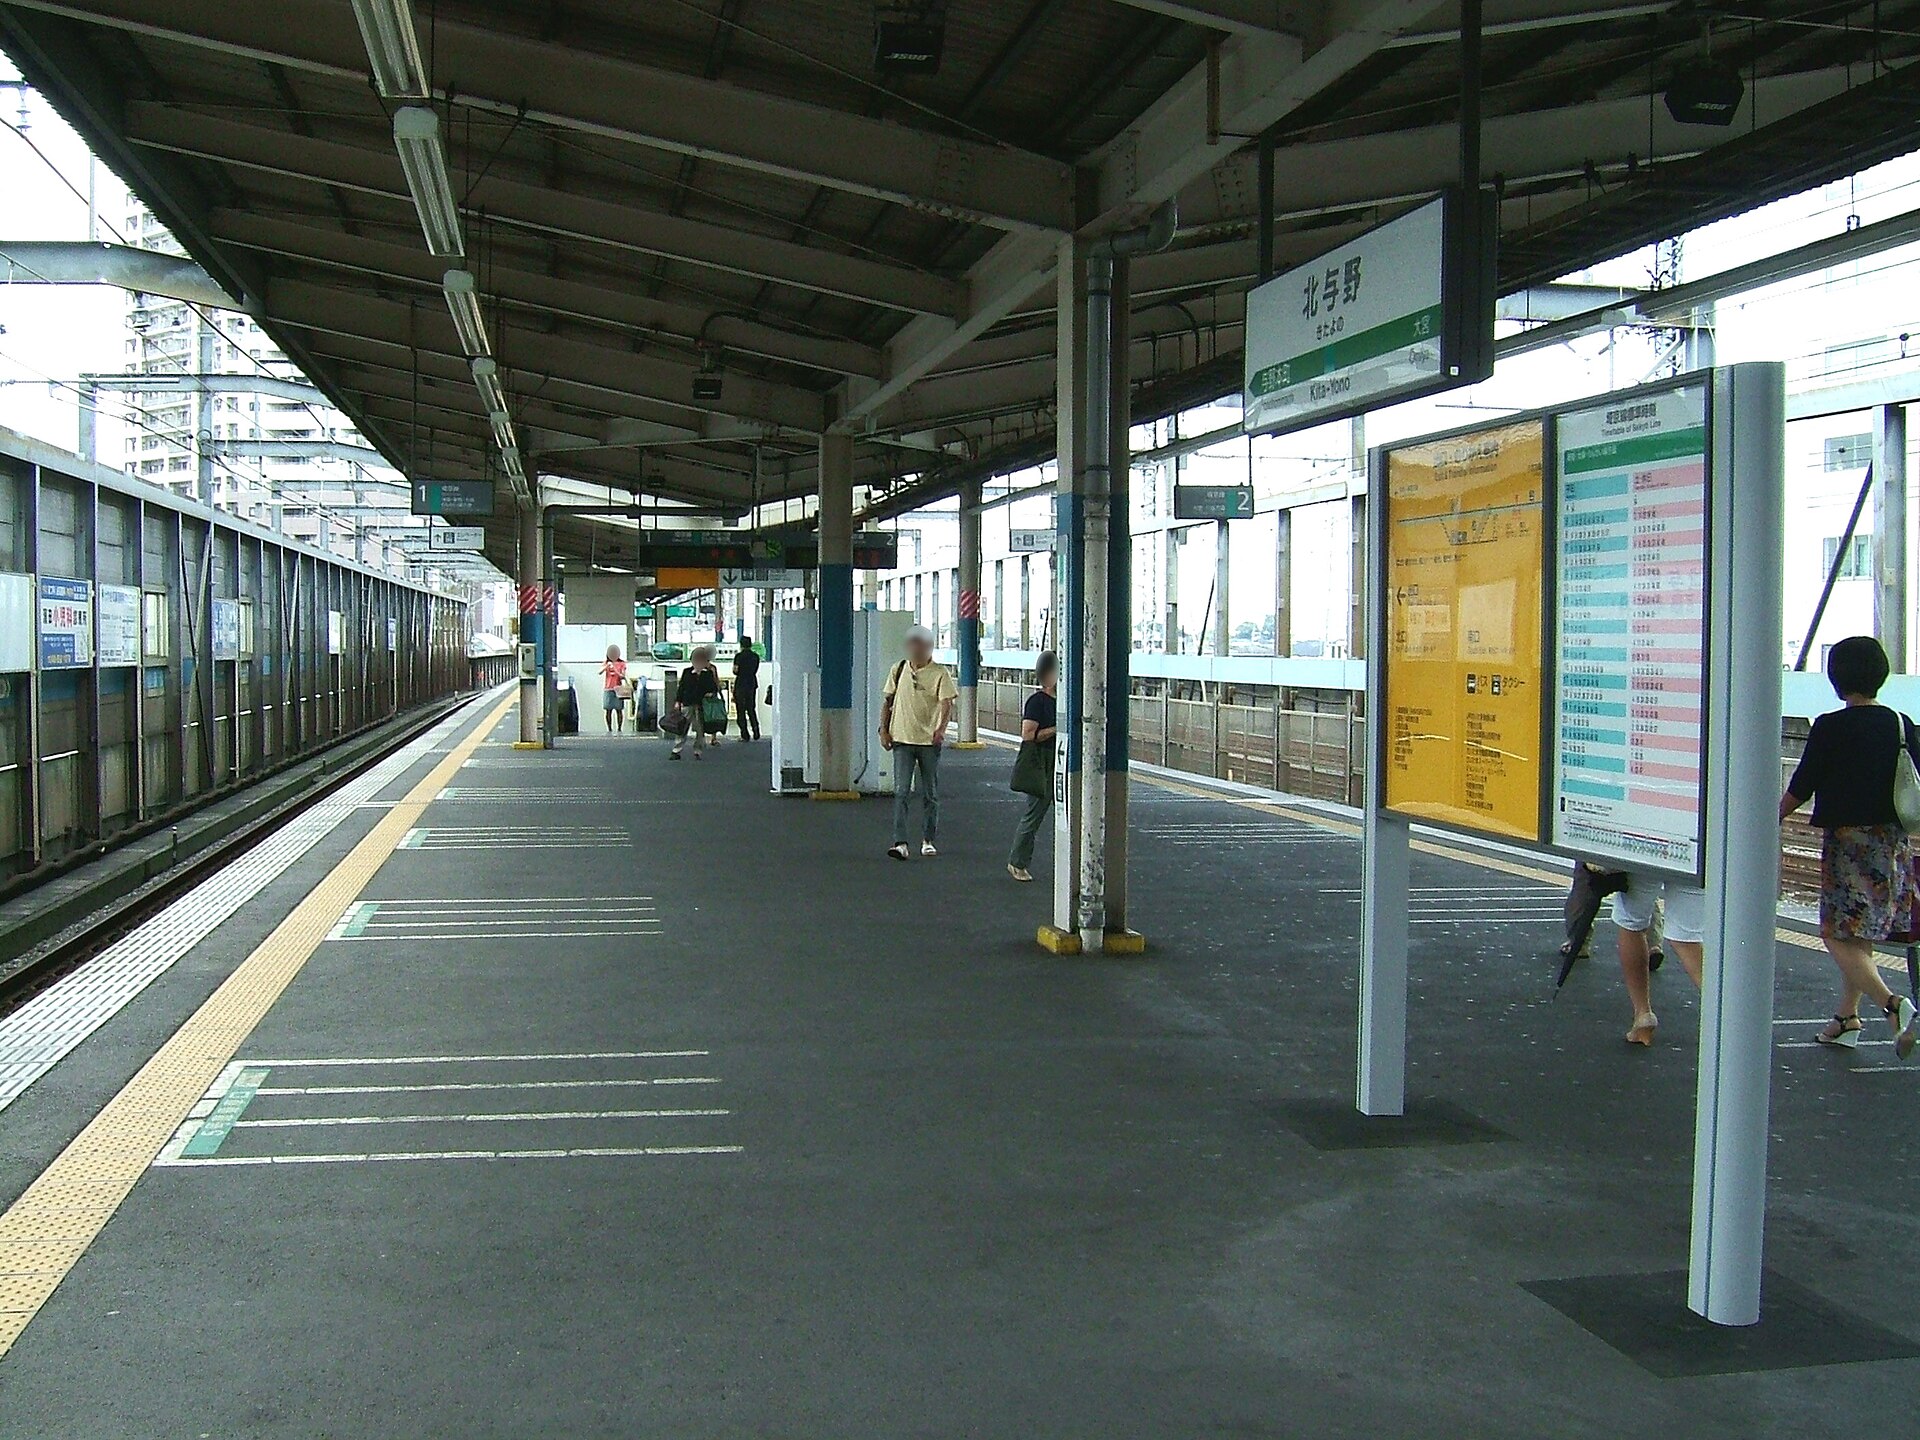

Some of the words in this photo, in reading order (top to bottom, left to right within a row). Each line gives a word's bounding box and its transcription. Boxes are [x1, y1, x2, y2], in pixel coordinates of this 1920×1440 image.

[1302, 255, 1362, 321] 北与野
[1315, 315, 1344, 341] きたよの
[1309, 375, 1351, 401] Kita-Yono
[418, 485, 427, 502] 1
[1237, 491, 1250, 511] 2
[886, 533, 895, 546] 2
[1502, 676, 1526, 689] タクシー
